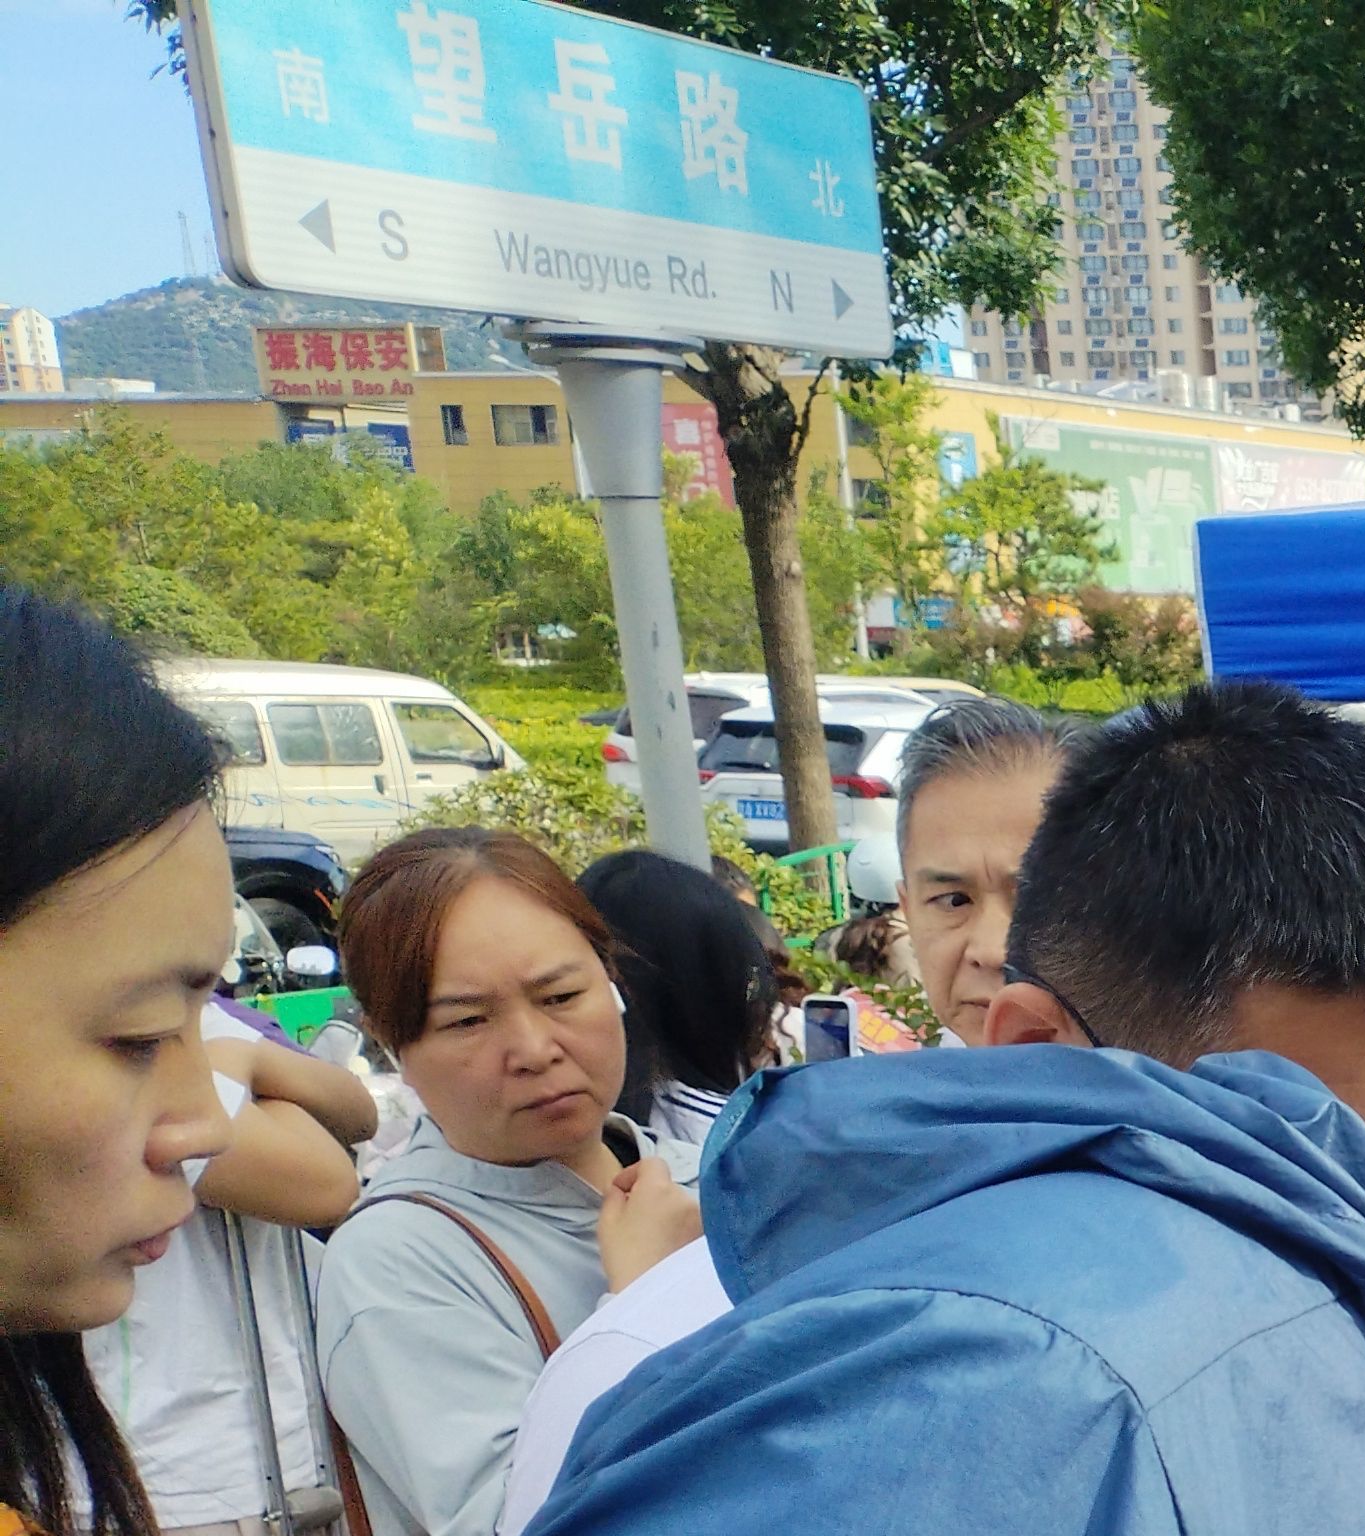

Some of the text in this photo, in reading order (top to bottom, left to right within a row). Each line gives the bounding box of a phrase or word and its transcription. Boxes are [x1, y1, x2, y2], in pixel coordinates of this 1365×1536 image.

[272, 1, 845, 218] 南 望岳路 北
[378, 209, 795, 314] S Wangyue Rd. N
[265, 332, 408, 372] 振海保安
